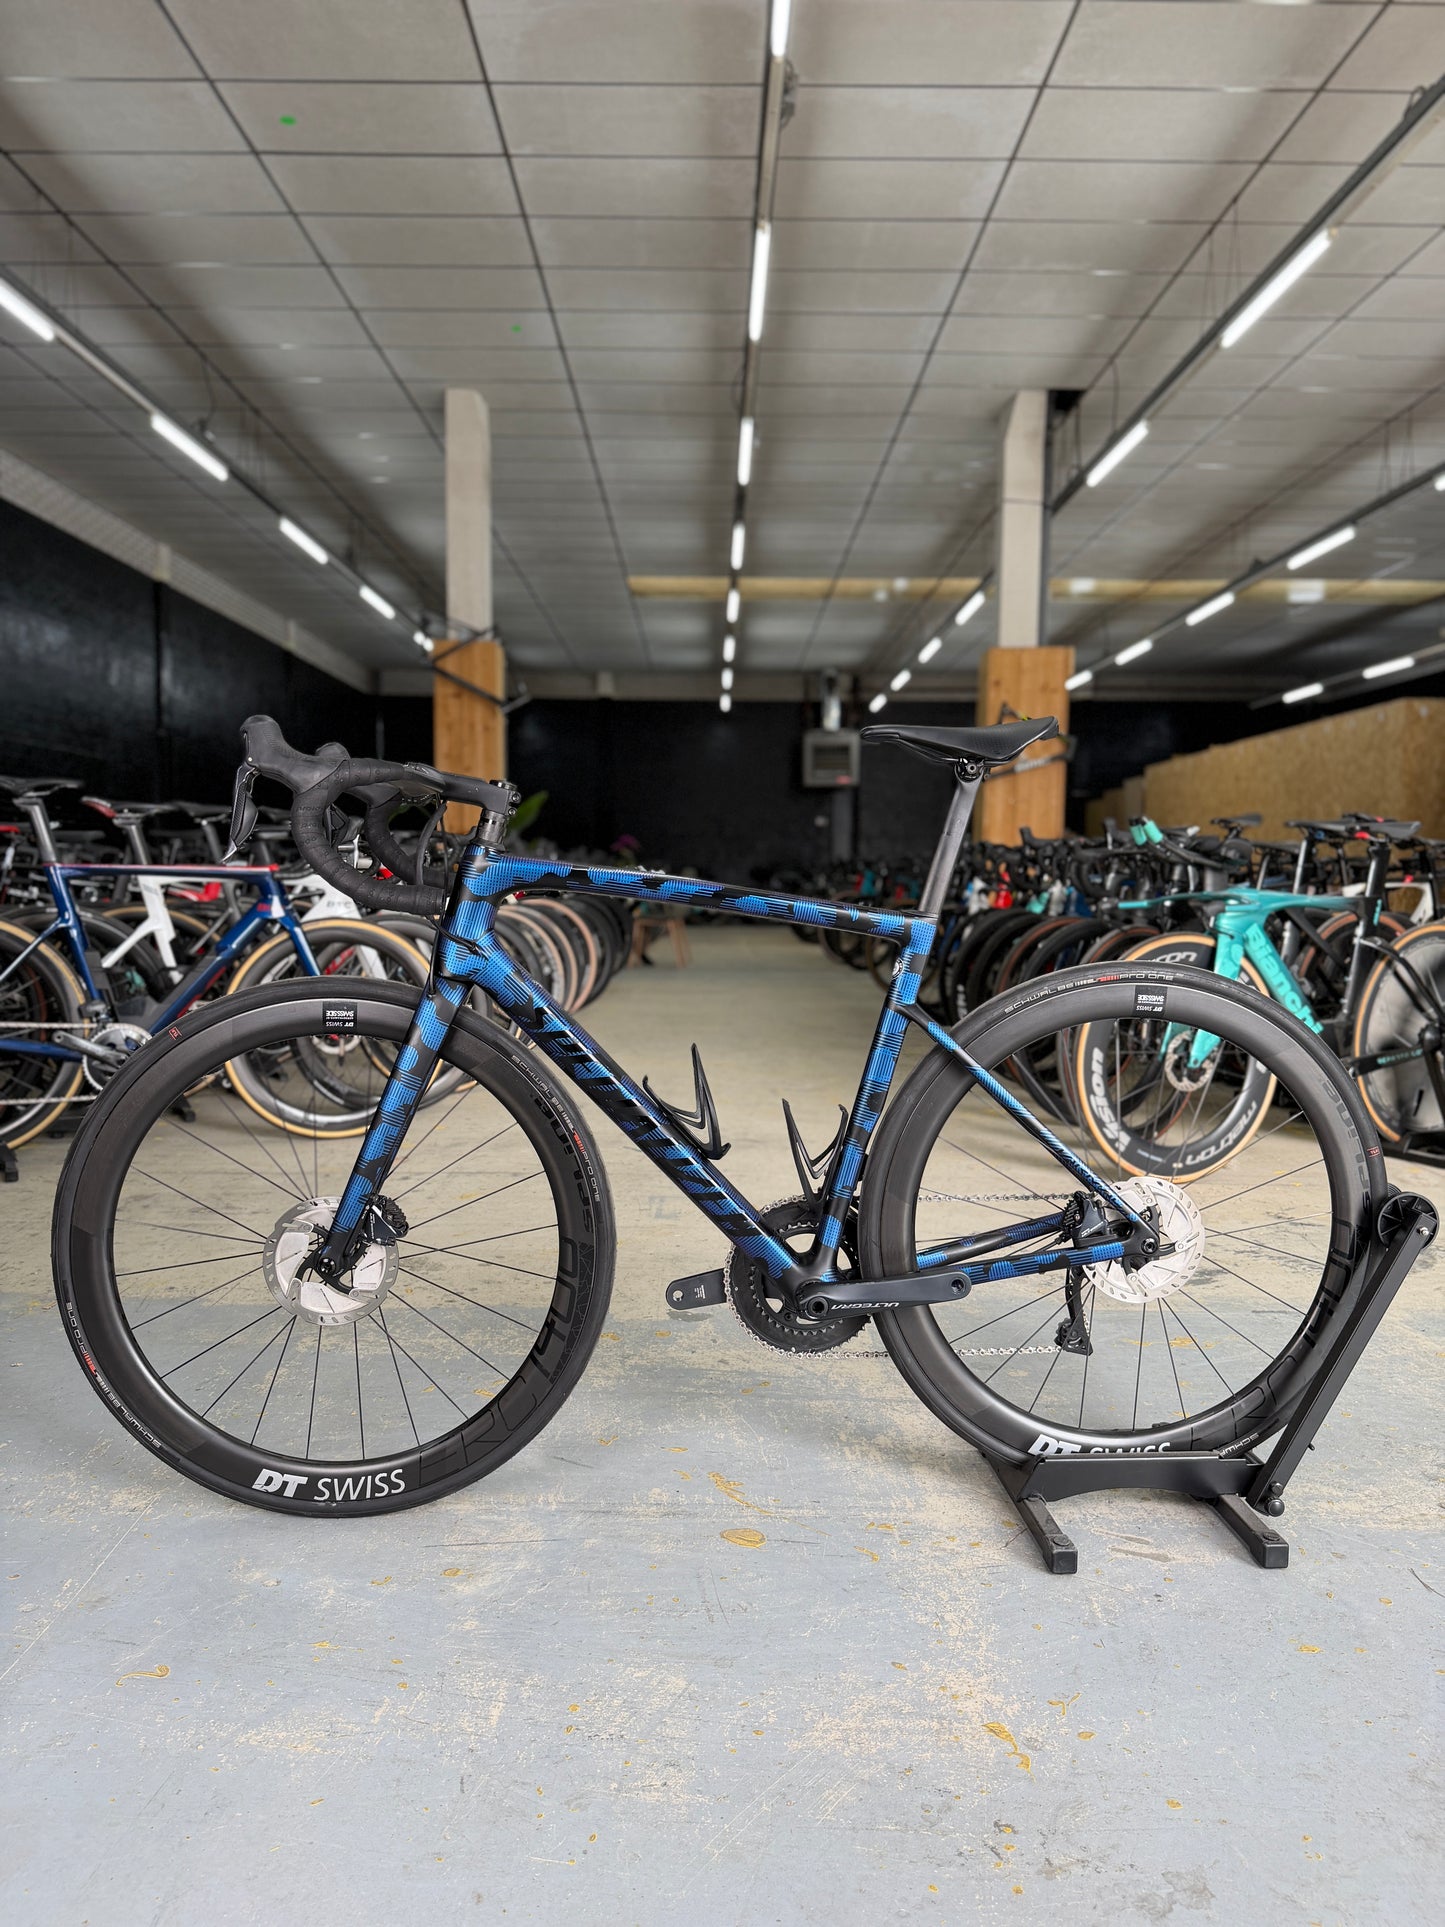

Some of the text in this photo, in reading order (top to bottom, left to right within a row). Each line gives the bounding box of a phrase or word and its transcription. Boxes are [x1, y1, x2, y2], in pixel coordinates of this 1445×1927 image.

[1004, 982, 1074, 1014] SCHWALBE
[511, 1055, 564, 1112] SCHWALBE
[831, 1301, 900, 1310] ULTEGRA
[106, 1392, 163, 1449] SCHWALBE
[1220, 1432, 1260, 1457] SCHWA
[251, 1468, 406, 1501] DT SWISS
